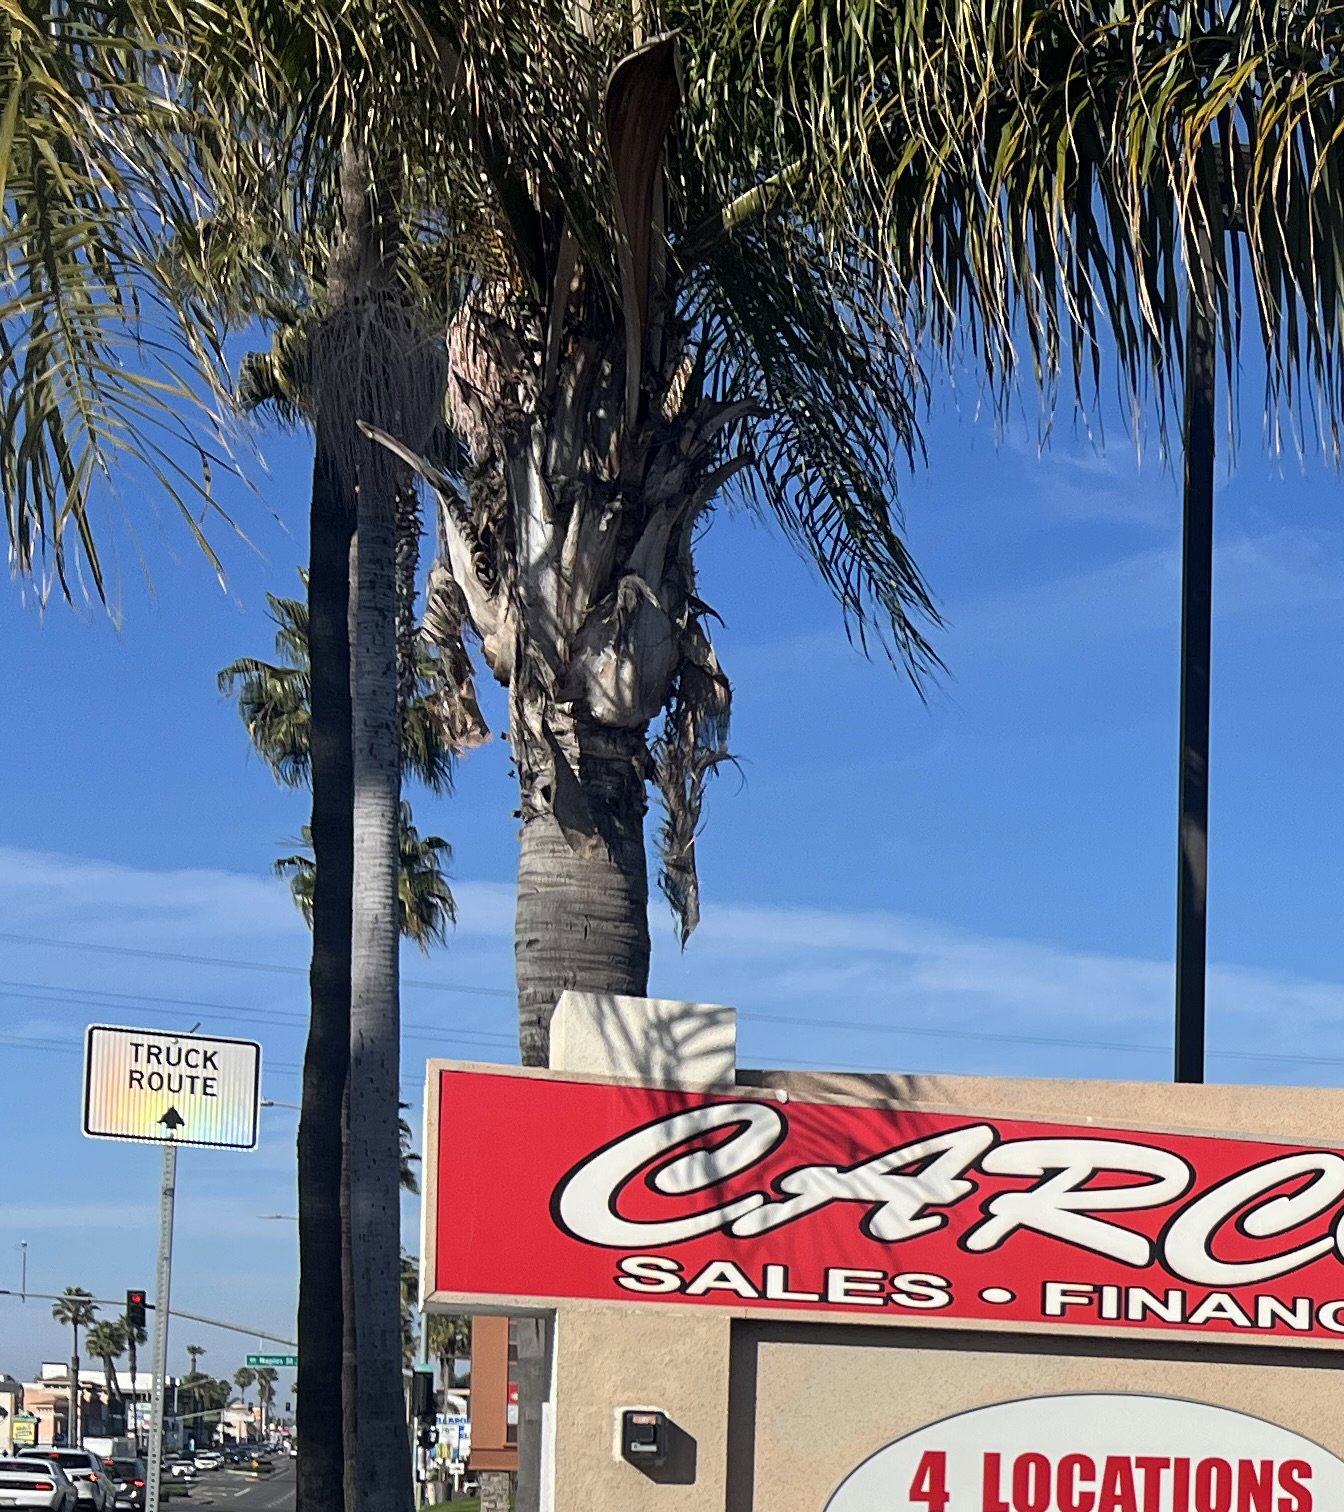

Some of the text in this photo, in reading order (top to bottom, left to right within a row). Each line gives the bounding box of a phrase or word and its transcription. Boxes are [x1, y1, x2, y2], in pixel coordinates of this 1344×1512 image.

[130, 1042, 219, 1071] TRUCK
[129, 1069, 217, 1097] ROUTE
[614, 1255, 955, 1309] SALES
